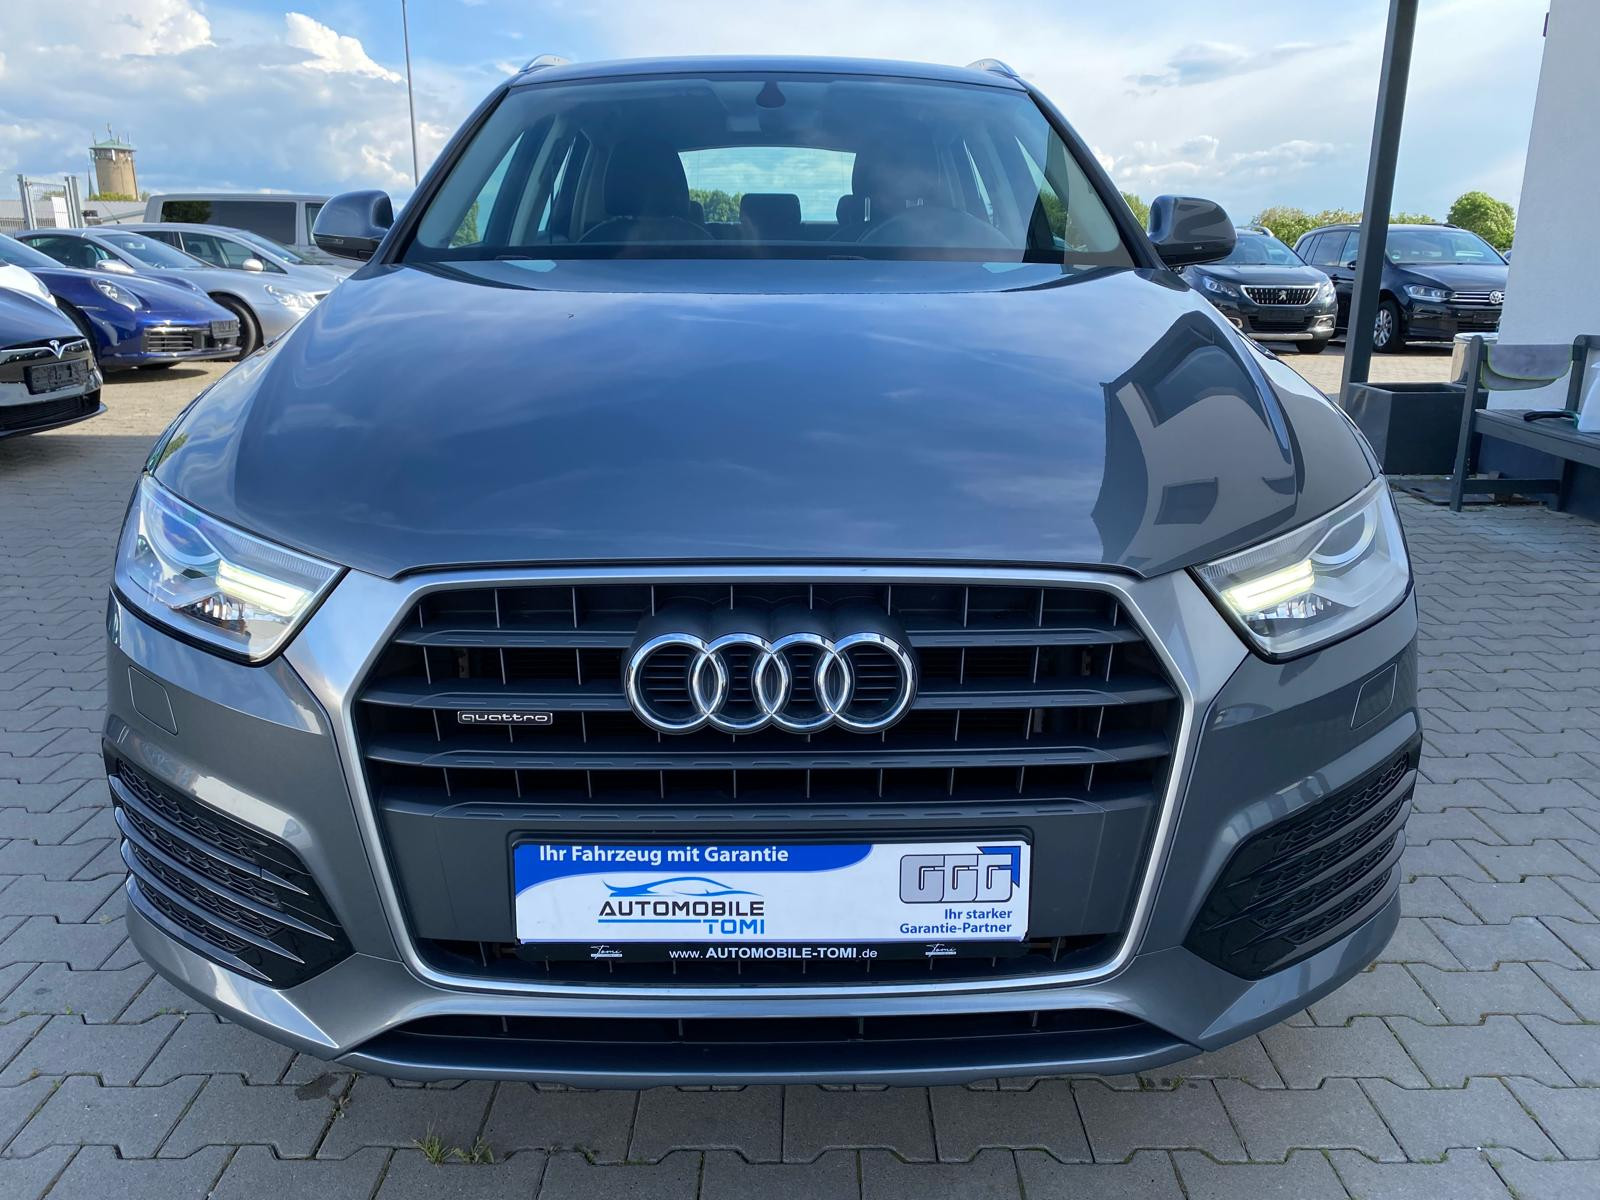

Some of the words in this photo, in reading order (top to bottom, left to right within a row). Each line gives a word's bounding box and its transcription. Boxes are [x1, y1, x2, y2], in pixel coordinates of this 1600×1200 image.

[461, 713, 548, 722] quattro
[539, 845, 567, 862] Ihr
[572, 846, 662, 866] Fahrzeug
[667, 846, 700, 862] mit
[704, 846, 789, 862] Garantie
[598, 900, 765, 917] AUTOMOBILE
[944, 909, 963, 919] Ihr
[966, 908, 1013, 919] starker
[701, 919, 765, 935] TOMI
[899, 922, 1012, 934] Garantie-Partner
